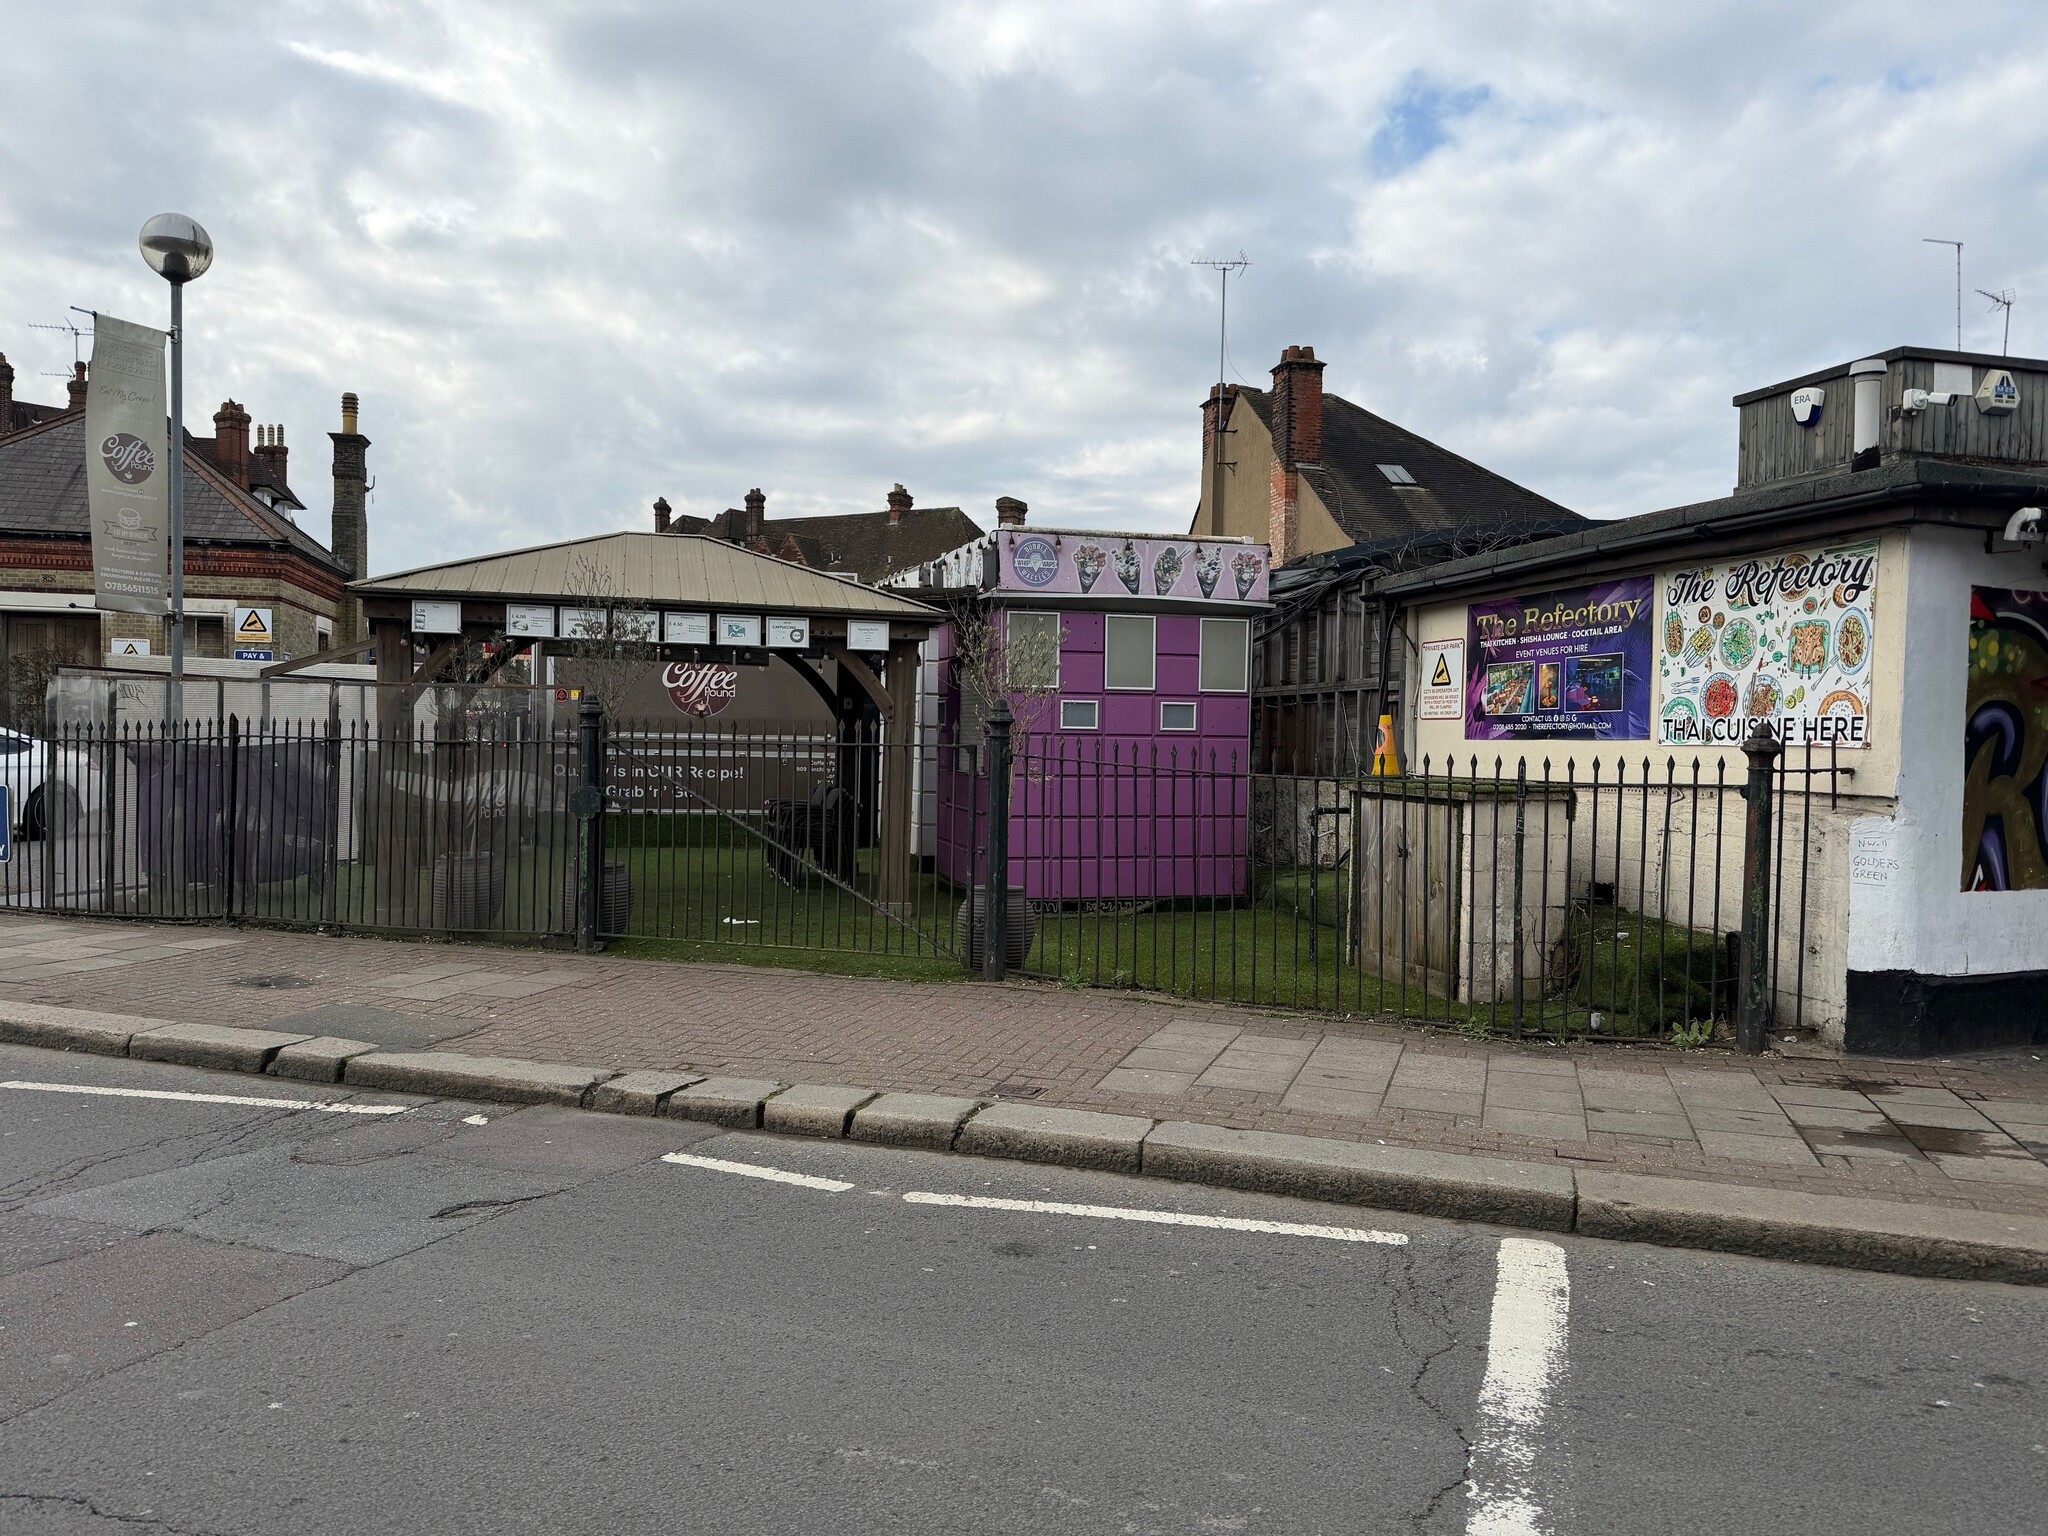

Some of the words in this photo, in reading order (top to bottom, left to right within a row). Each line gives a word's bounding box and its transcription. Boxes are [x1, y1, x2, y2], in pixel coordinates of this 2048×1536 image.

[1794, 395, 1810, 404] ERA
[99, 434, 156, 471] Coffee
[1024, 543, 1048, 553] BUBBLE
[1021, 568, 1050, 581] WAFFLES
[1668, 572, 1716, 607] The
[1725, 554, 1875, 607] Refectory
[104, 581, 159, 595] 07856511515
[1477, 614, 1517, 640] The
[1522, 599, 1642, 634] Refectory
[1480, 640, 1492, 649] THAI
[1492, 638, 1516, 647] KITCHEN
[1520, 635, 1542, 644] SHISHA
[1542, 631, 1568, 642] LOUNGE
[1571, 627, 1603, 638] COCKTAIL
[1603, 625, 1623, 635] AREA
[1516, 650, 1534, 659] EVENT
[1536, 647, 1559, 656] VENUES
[1560, 645, 1573, 654] FOR
[1574, 644, 1588, 653] HIRE
[662, 662, 738, 704] Coffee
[704, 684, 736, 697] Pound
[1522, 715, 1544, 723] CONTACT
[1663, 719, 1706, 741] THAI
[1712, 717, 1795, 741] CUISNE
[1803, 716, 1864, 741] HERE
[614, 765, 626, 777] is
[631, 765, 644, 777] in
[606, 785, 644, 798] Grab
[1853, 856, 1899, 870] GOLDERS
[1853, 868, 1887, 880] GREEN
